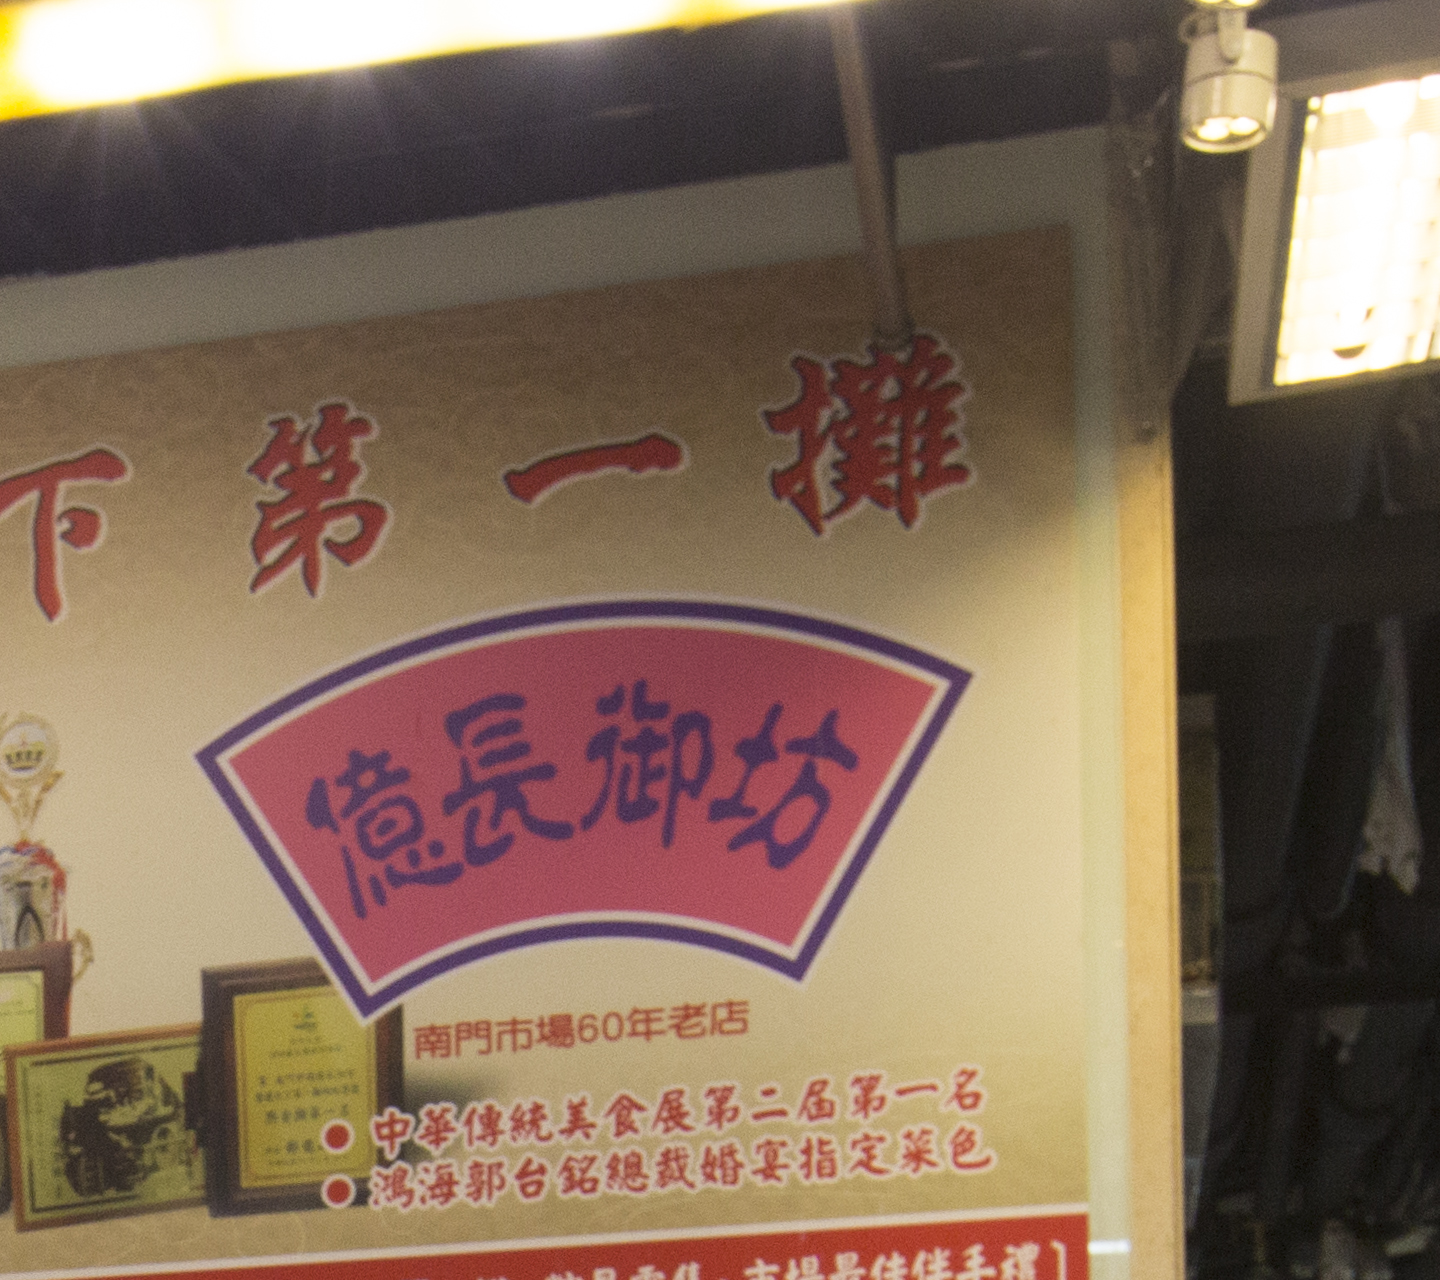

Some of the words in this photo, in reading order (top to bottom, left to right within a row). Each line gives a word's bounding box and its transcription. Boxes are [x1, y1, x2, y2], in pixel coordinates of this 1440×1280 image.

[305, 680, 859, 920] 億長御坊
[414, 1001, 751, 1060] 南門市場60年老店
[372, 1065, 986, 1158] 中華傳統美食展第二屆第一名
[370, 1126, 994, 1212] 鴻海郭台銘總裁婚宴指定菜色
